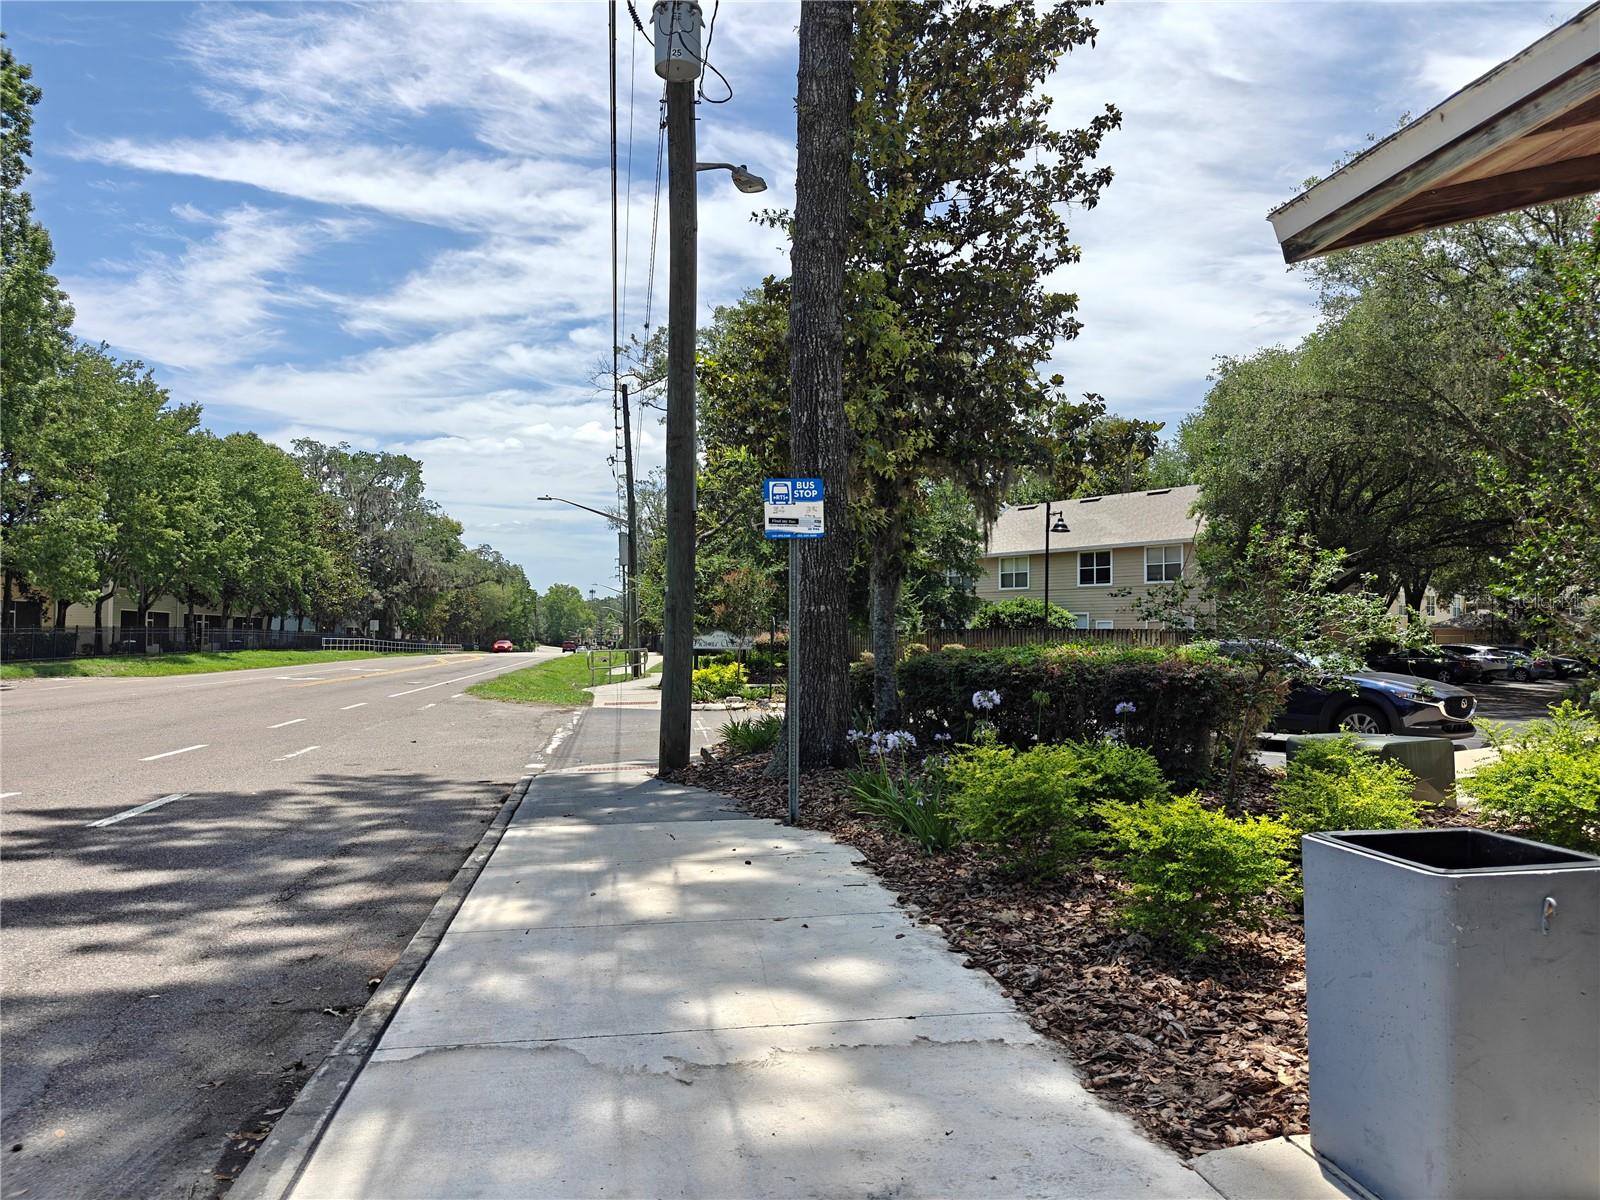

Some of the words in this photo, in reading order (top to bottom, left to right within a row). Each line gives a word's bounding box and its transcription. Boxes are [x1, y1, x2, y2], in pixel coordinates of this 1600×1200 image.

[672, 49, 682, 57] 25
[796, 481, 815, 489] BUS
[794, 490, 818, 498] STOP
